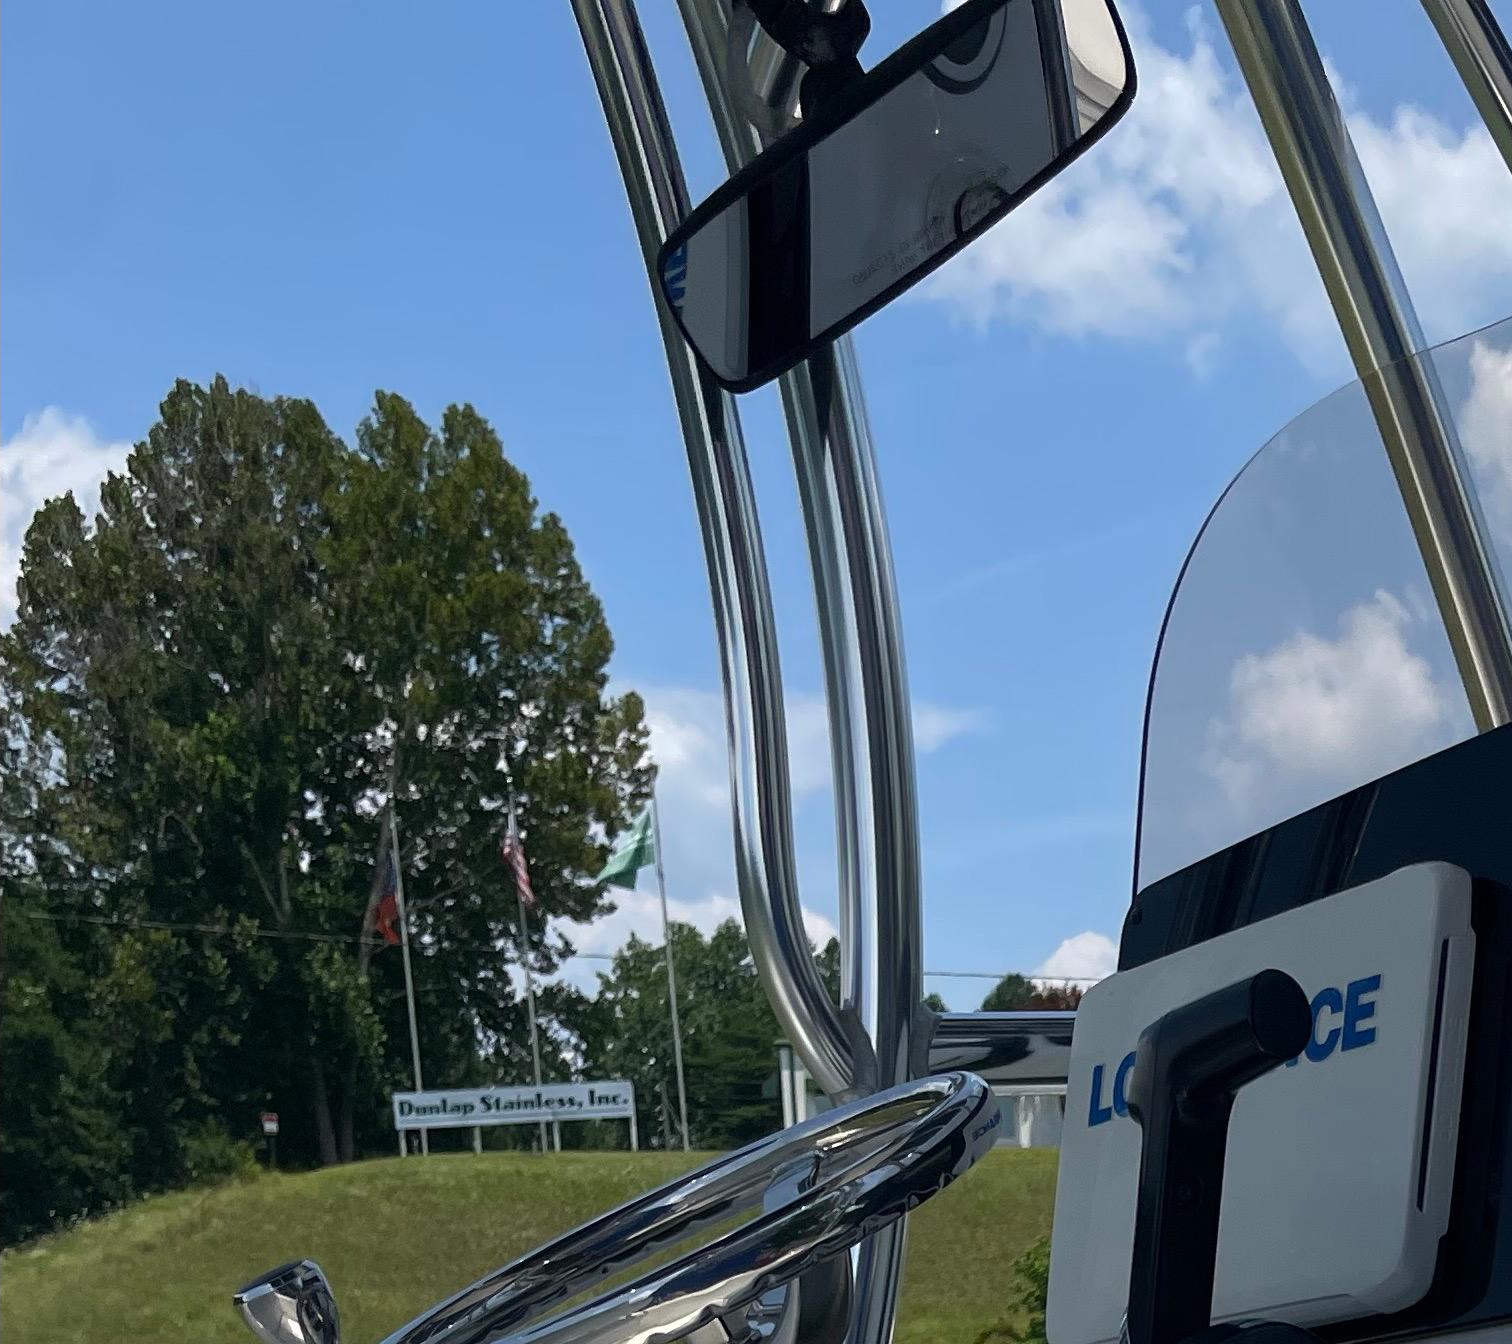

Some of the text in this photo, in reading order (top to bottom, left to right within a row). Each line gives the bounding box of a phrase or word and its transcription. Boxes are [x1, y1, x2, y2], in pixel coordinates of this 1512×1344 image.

[398, 1089, 629, 1117] Dunlap Stainless, Inc.
